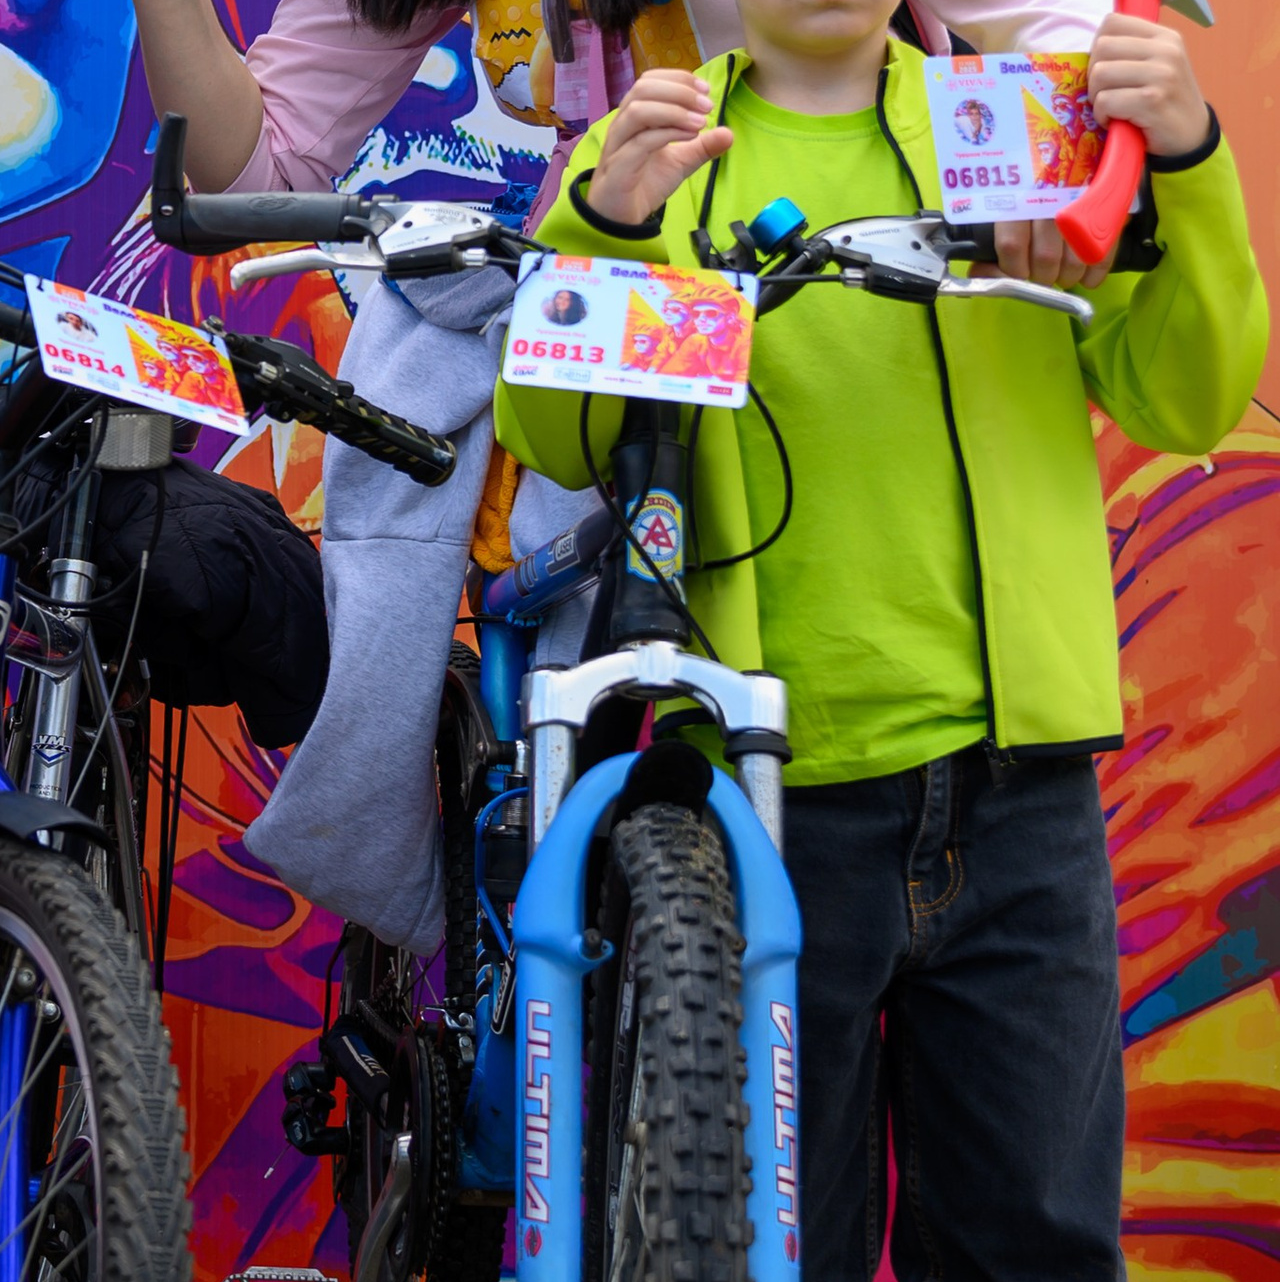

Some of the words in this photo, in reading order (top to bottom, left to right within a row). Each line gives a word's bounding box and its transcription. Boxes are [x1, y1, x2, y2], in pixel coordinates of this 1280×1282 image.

[943, 164, 1021, 189] 06815
[44, 343, 126, 379] 06814
[512, 339, 606, 364] 06813
[525, 999, 551, 1223] ULTIMA
[770, 1000, 797, 1227] ULTIMA
